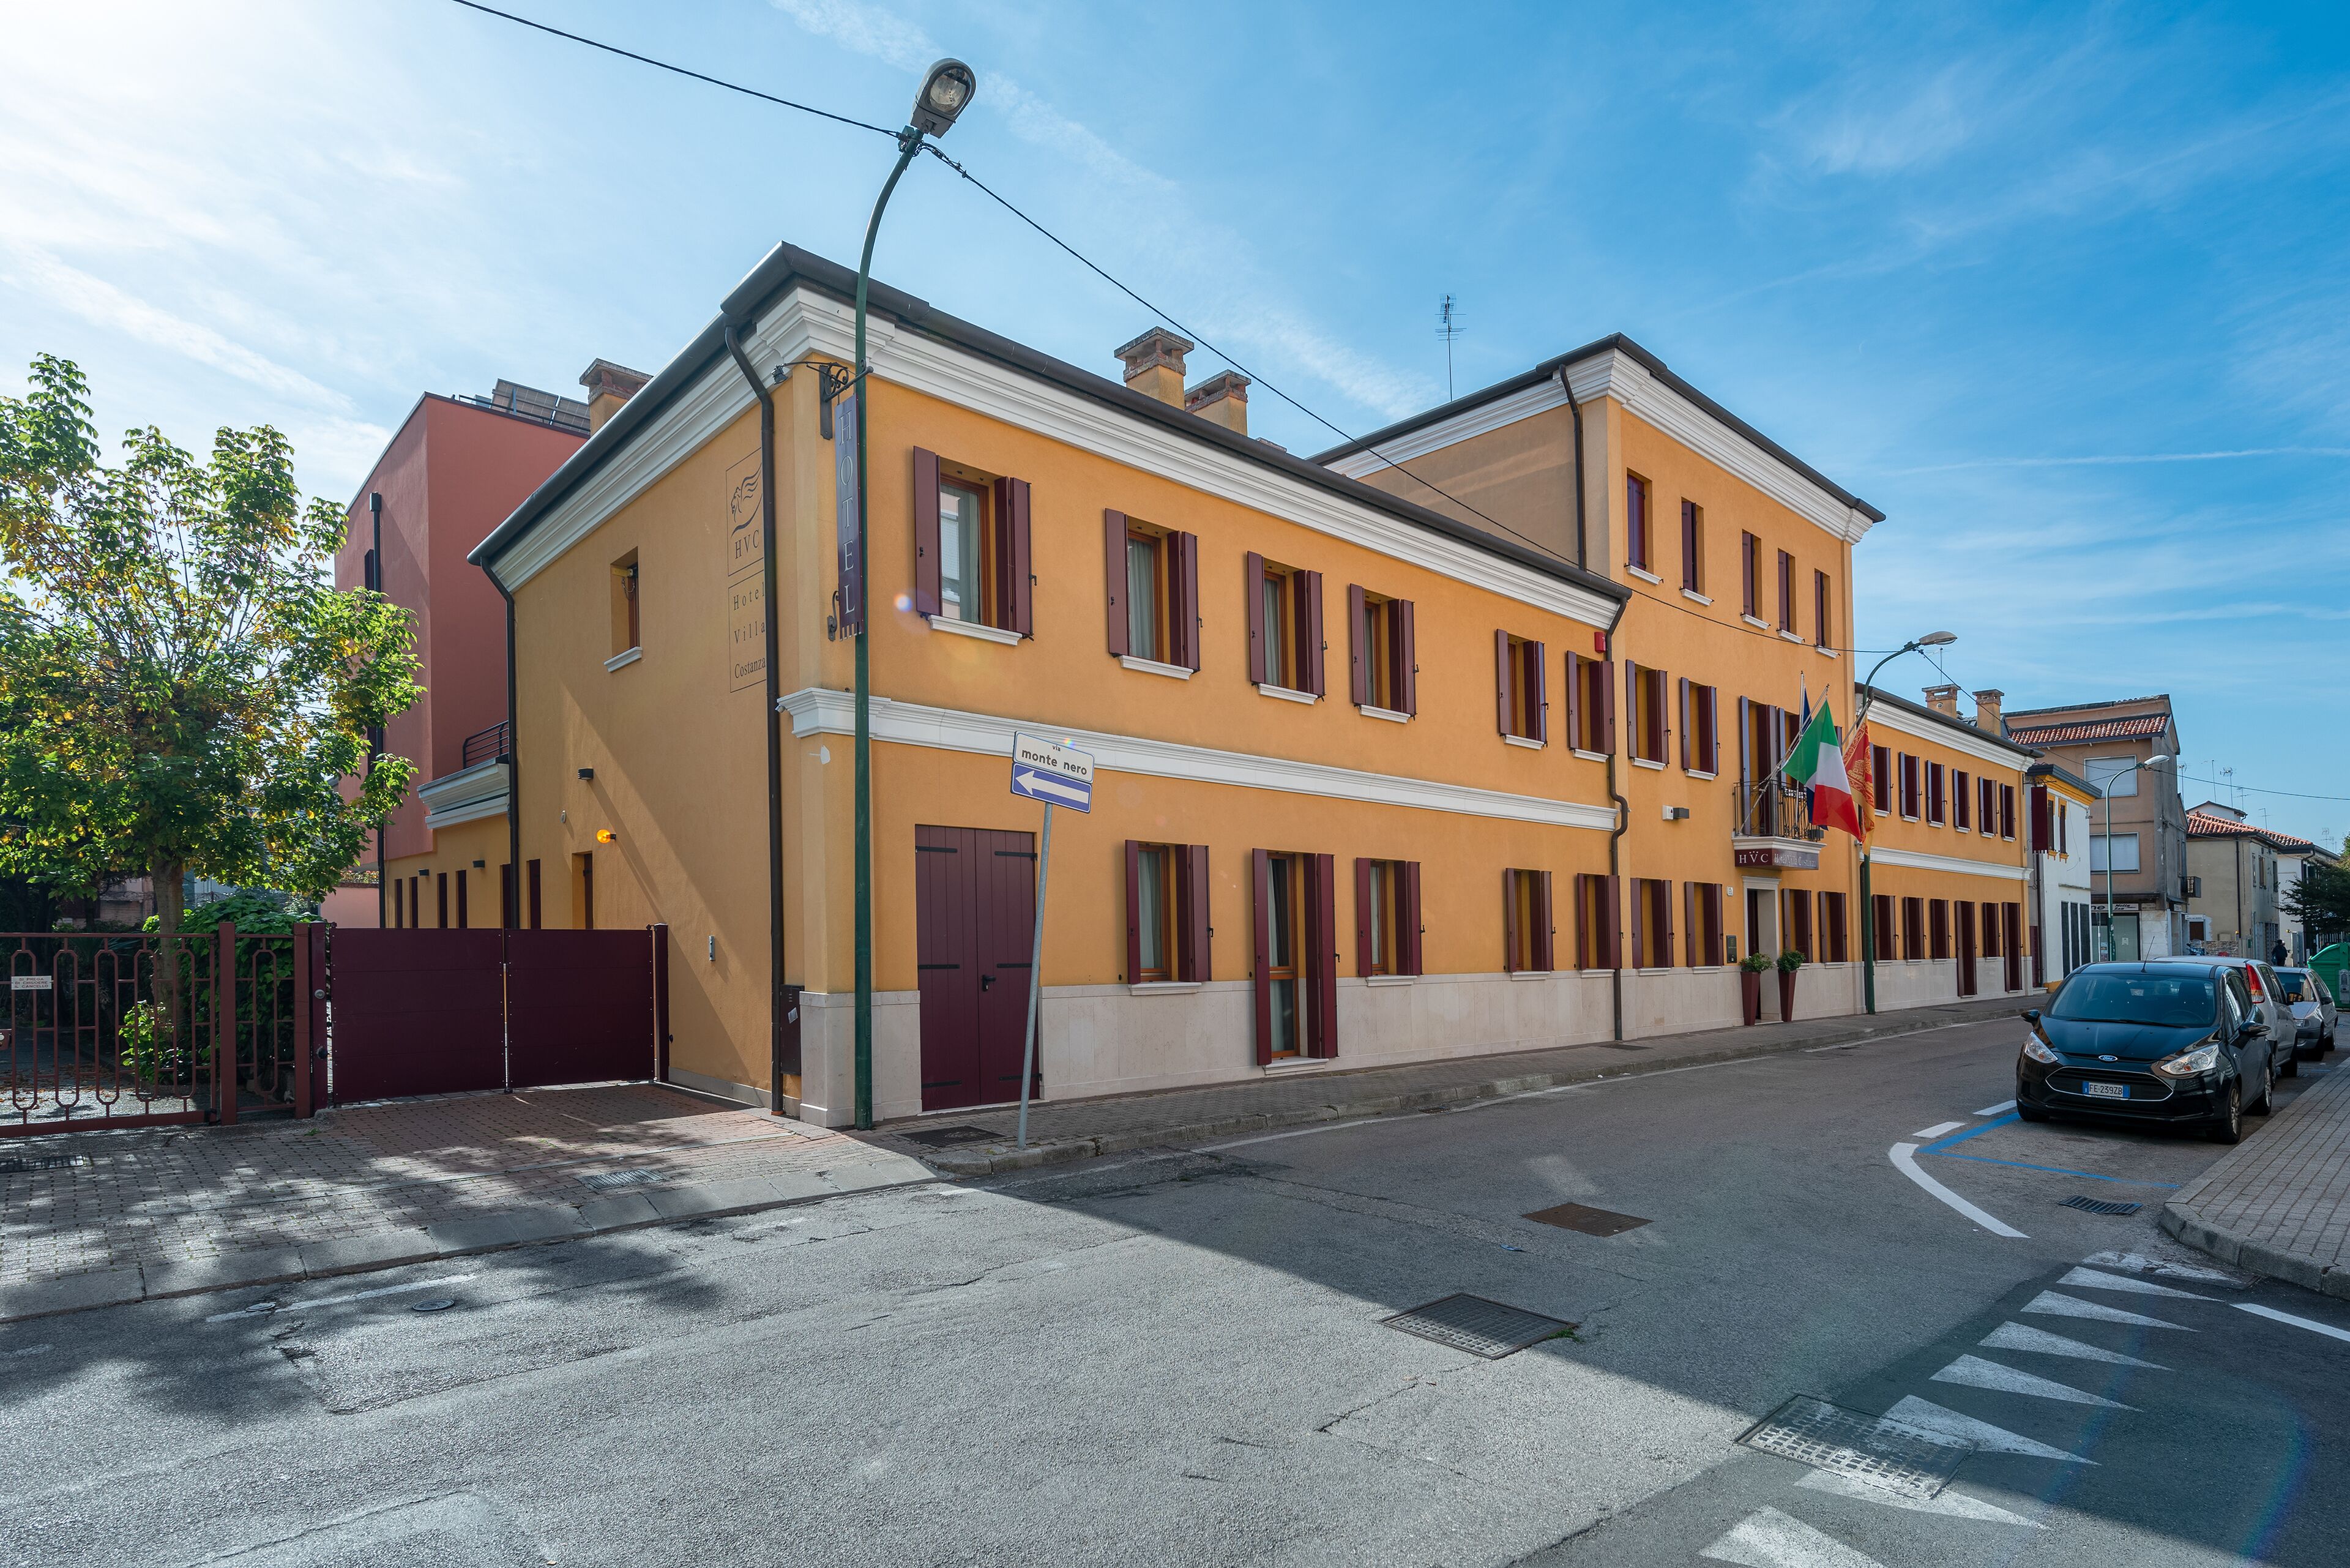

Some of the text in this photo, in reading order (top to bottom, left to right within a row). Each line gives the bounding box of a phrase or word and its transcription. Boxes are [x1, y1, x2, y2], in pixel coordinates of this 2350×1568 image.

[838, 409, 856, 614] HOTEL
[735, 529, 759, 559] HVC
[733, 581, 764, 611] Hotel
[734, 621, 765, 644] Villa
[734, 657, 766, 679] Costanza
[1021, 749, 1087, 775] monte nero
[1739, 853, 1769, 864] HVC
